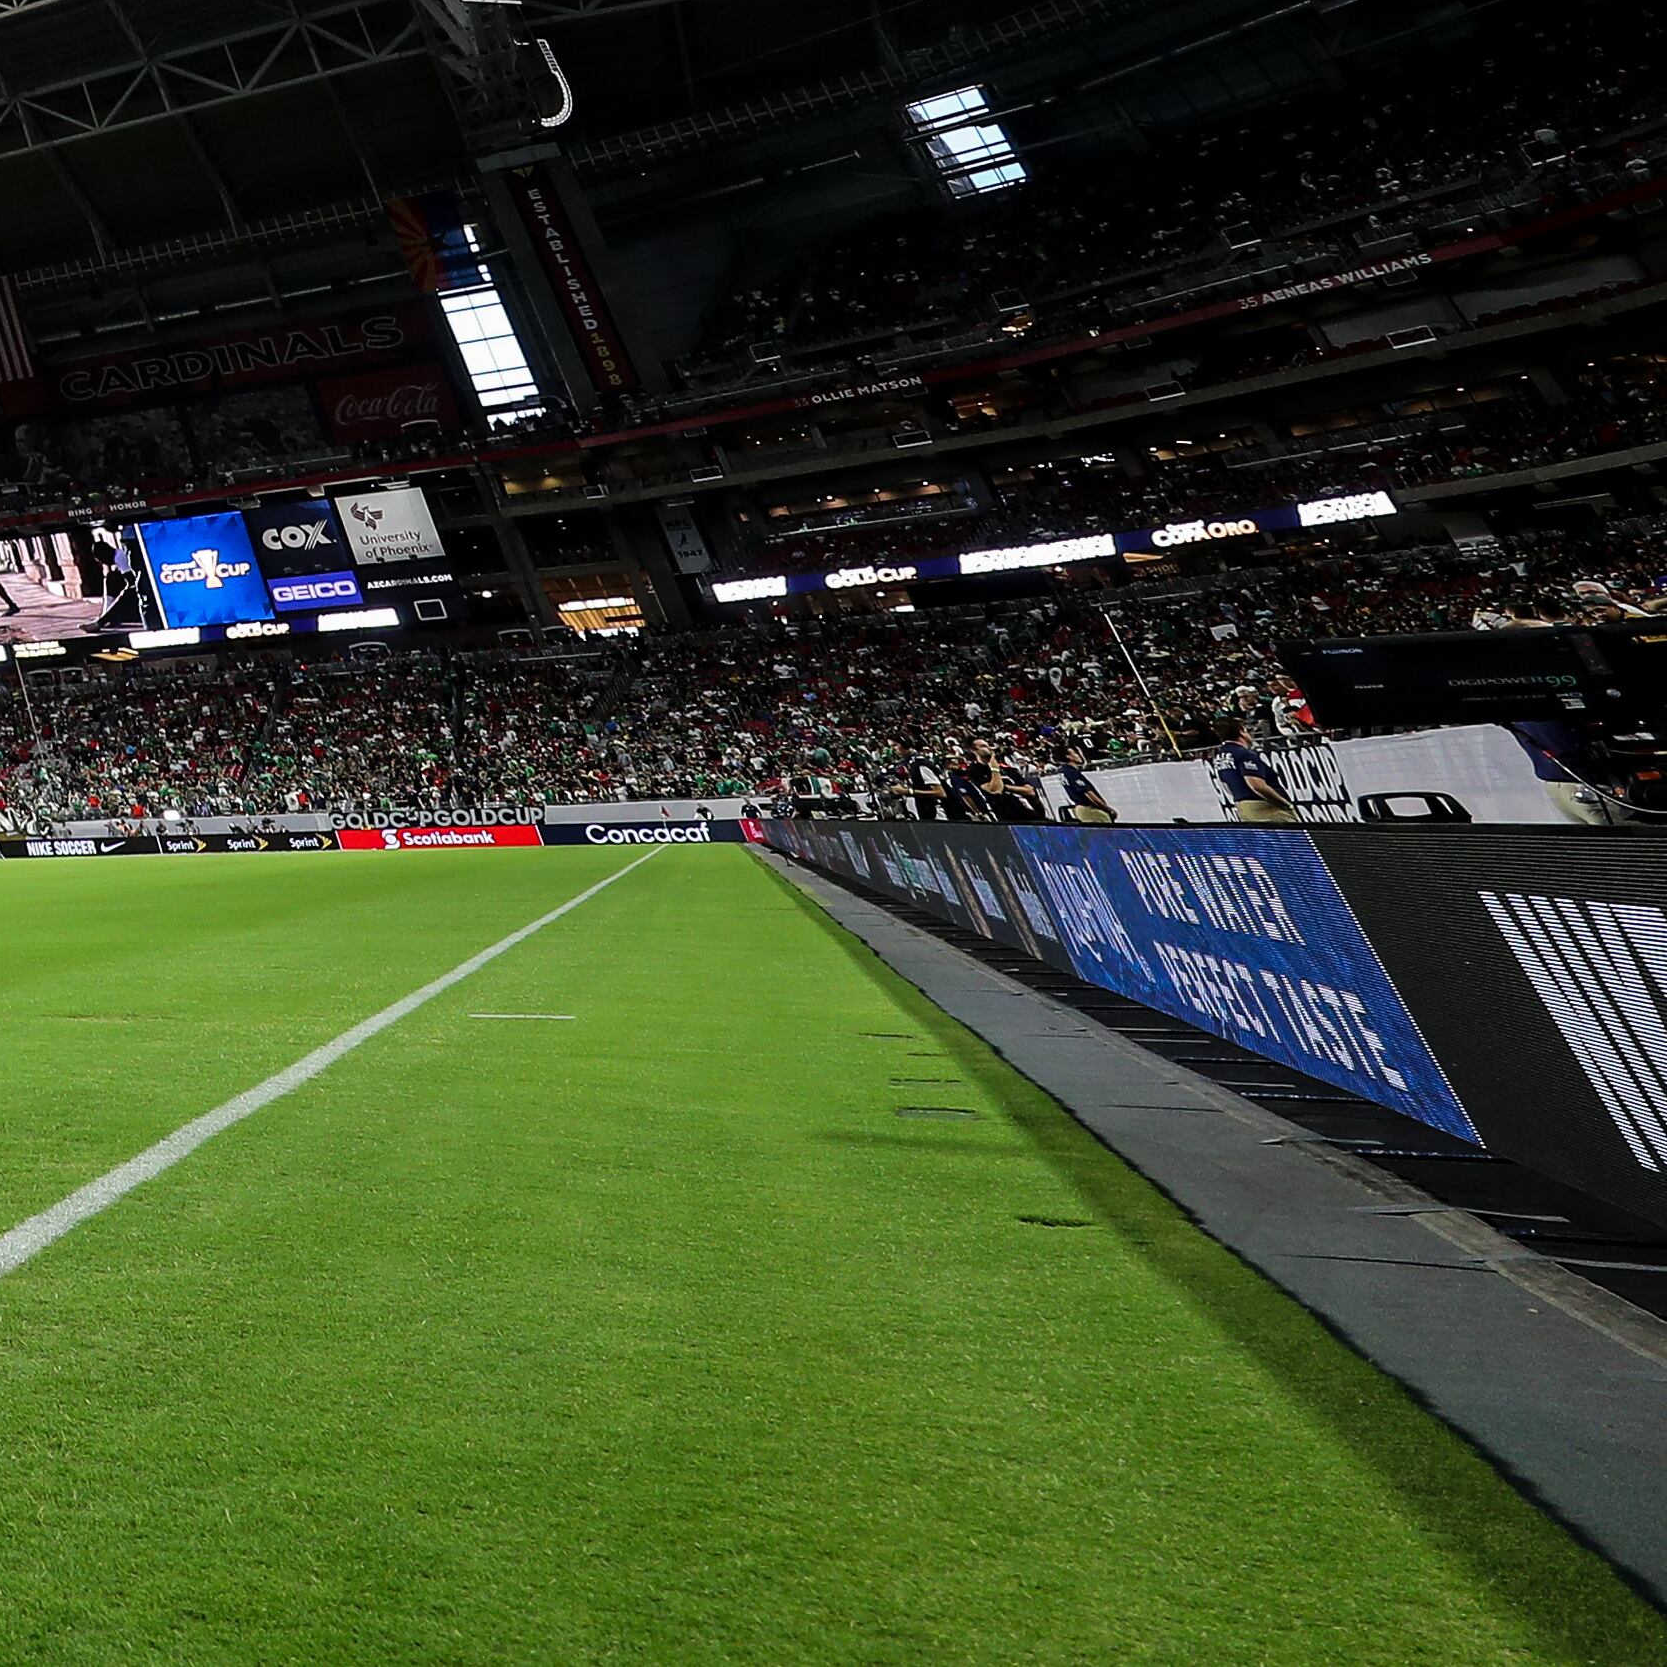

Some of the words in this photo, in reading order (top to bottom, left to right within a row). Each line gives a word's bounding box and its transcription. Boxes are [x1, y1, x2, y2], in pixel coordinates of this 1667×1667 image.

[527, 188, 599, 331] ESTABLISHED
[1237, 298, 1258, 310] 35
[1262, 277, 1334, 305] AENEAS
[1336, 253, 1433, 285] WILLIAMS
[58, 316, 405, 402] CARDINALS
[591, 333, 623, 385] 1898
[811, 388, 855, 404] OLLIE
[857, 376, 923, 397] MATSON
[334, 381, 439, 426] Coca-Cola
[68, 507, 93, 517] RING
[109, 500, 146, 511] HONOR
[262, 519, 329, 550] COX
[360, 529, 422, 545] University
[1151, 526, 1212, 547] COPA
[1206, 519, 1259, 536] ORO
[365, 546, 378, 558] of
[380, 542, 430, 556] Phoenix
[160, 566, 204, 584] GOLD
[216, 562, 251, 577] CUP
[367, 574, 453, 590] AZCARDINALS.COM
[824, 569, 876, 590] GOLD
[875, 566, 917, 583] CUP
[272, 580, 357, 603] GEICO
[262, 622, 291, 636] CUP
[1447, 676, 1543, 687] DIGIPOWER
[402, 830, 495, 846] Scotiabank
[585, 821, 711, 843] Concacaf
[26, 840, 55, 857] NIKE
[55, 839, 97, 856] SOCCER
[166, 839, 197, 853] Sprint
[227, 837, 257, 852] Sprint
[289, 836, 320, 851] Sprint
[1118, 848, 1200, 924] PURE
[1175, 854, 1306, 947] WATER
[1153, 940, 1281, 1045] PERFECT
[1260, 969, 1409, 1093] TASTE
